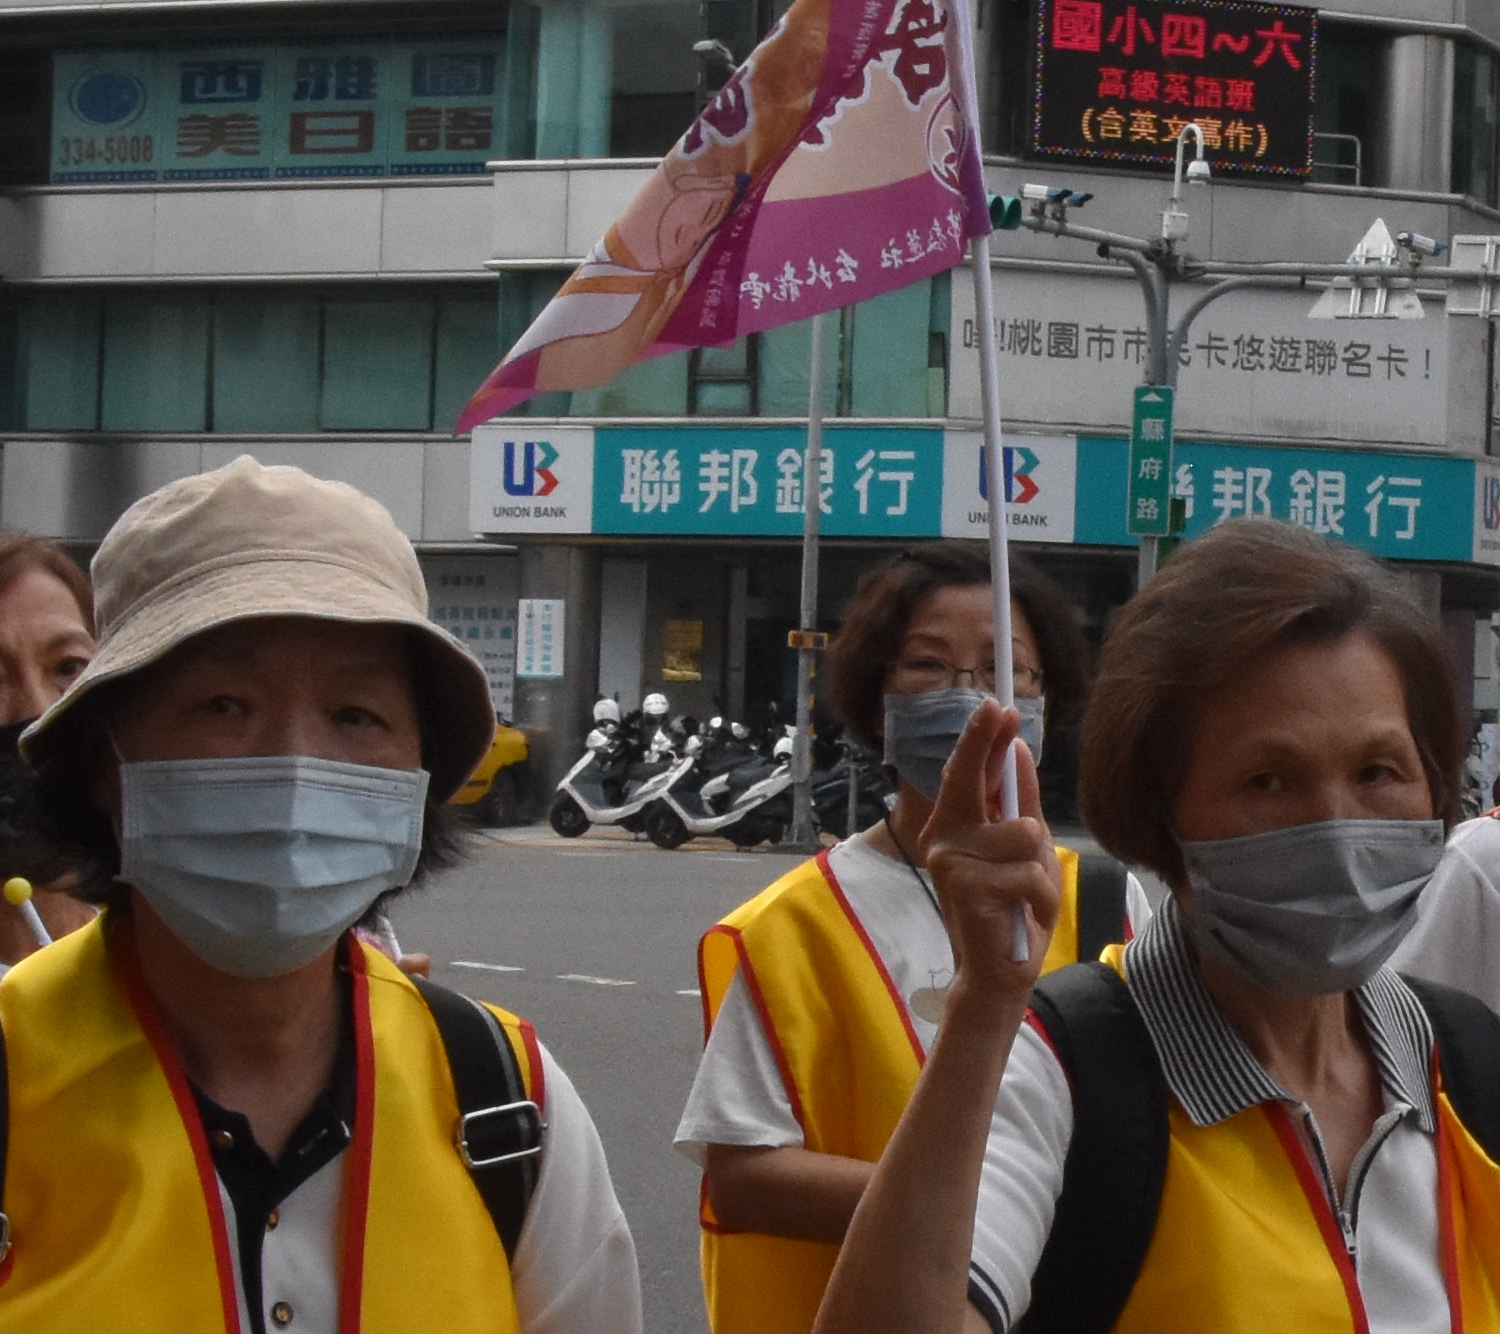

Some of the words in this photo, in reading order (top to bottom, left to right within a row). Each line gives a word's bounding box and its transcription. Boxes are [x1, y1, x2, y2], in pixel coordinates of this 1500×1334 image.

[175, 106, 495, 158] 美日語
[619, 447, 917, 516] 聯邦銀行
[1135, 417, 1165, 522] 縣府路
[493, 506, 533, 518] UNION
[534, 506, 568, 519] BANK
[1012, 513, 1049, 527] BANK
